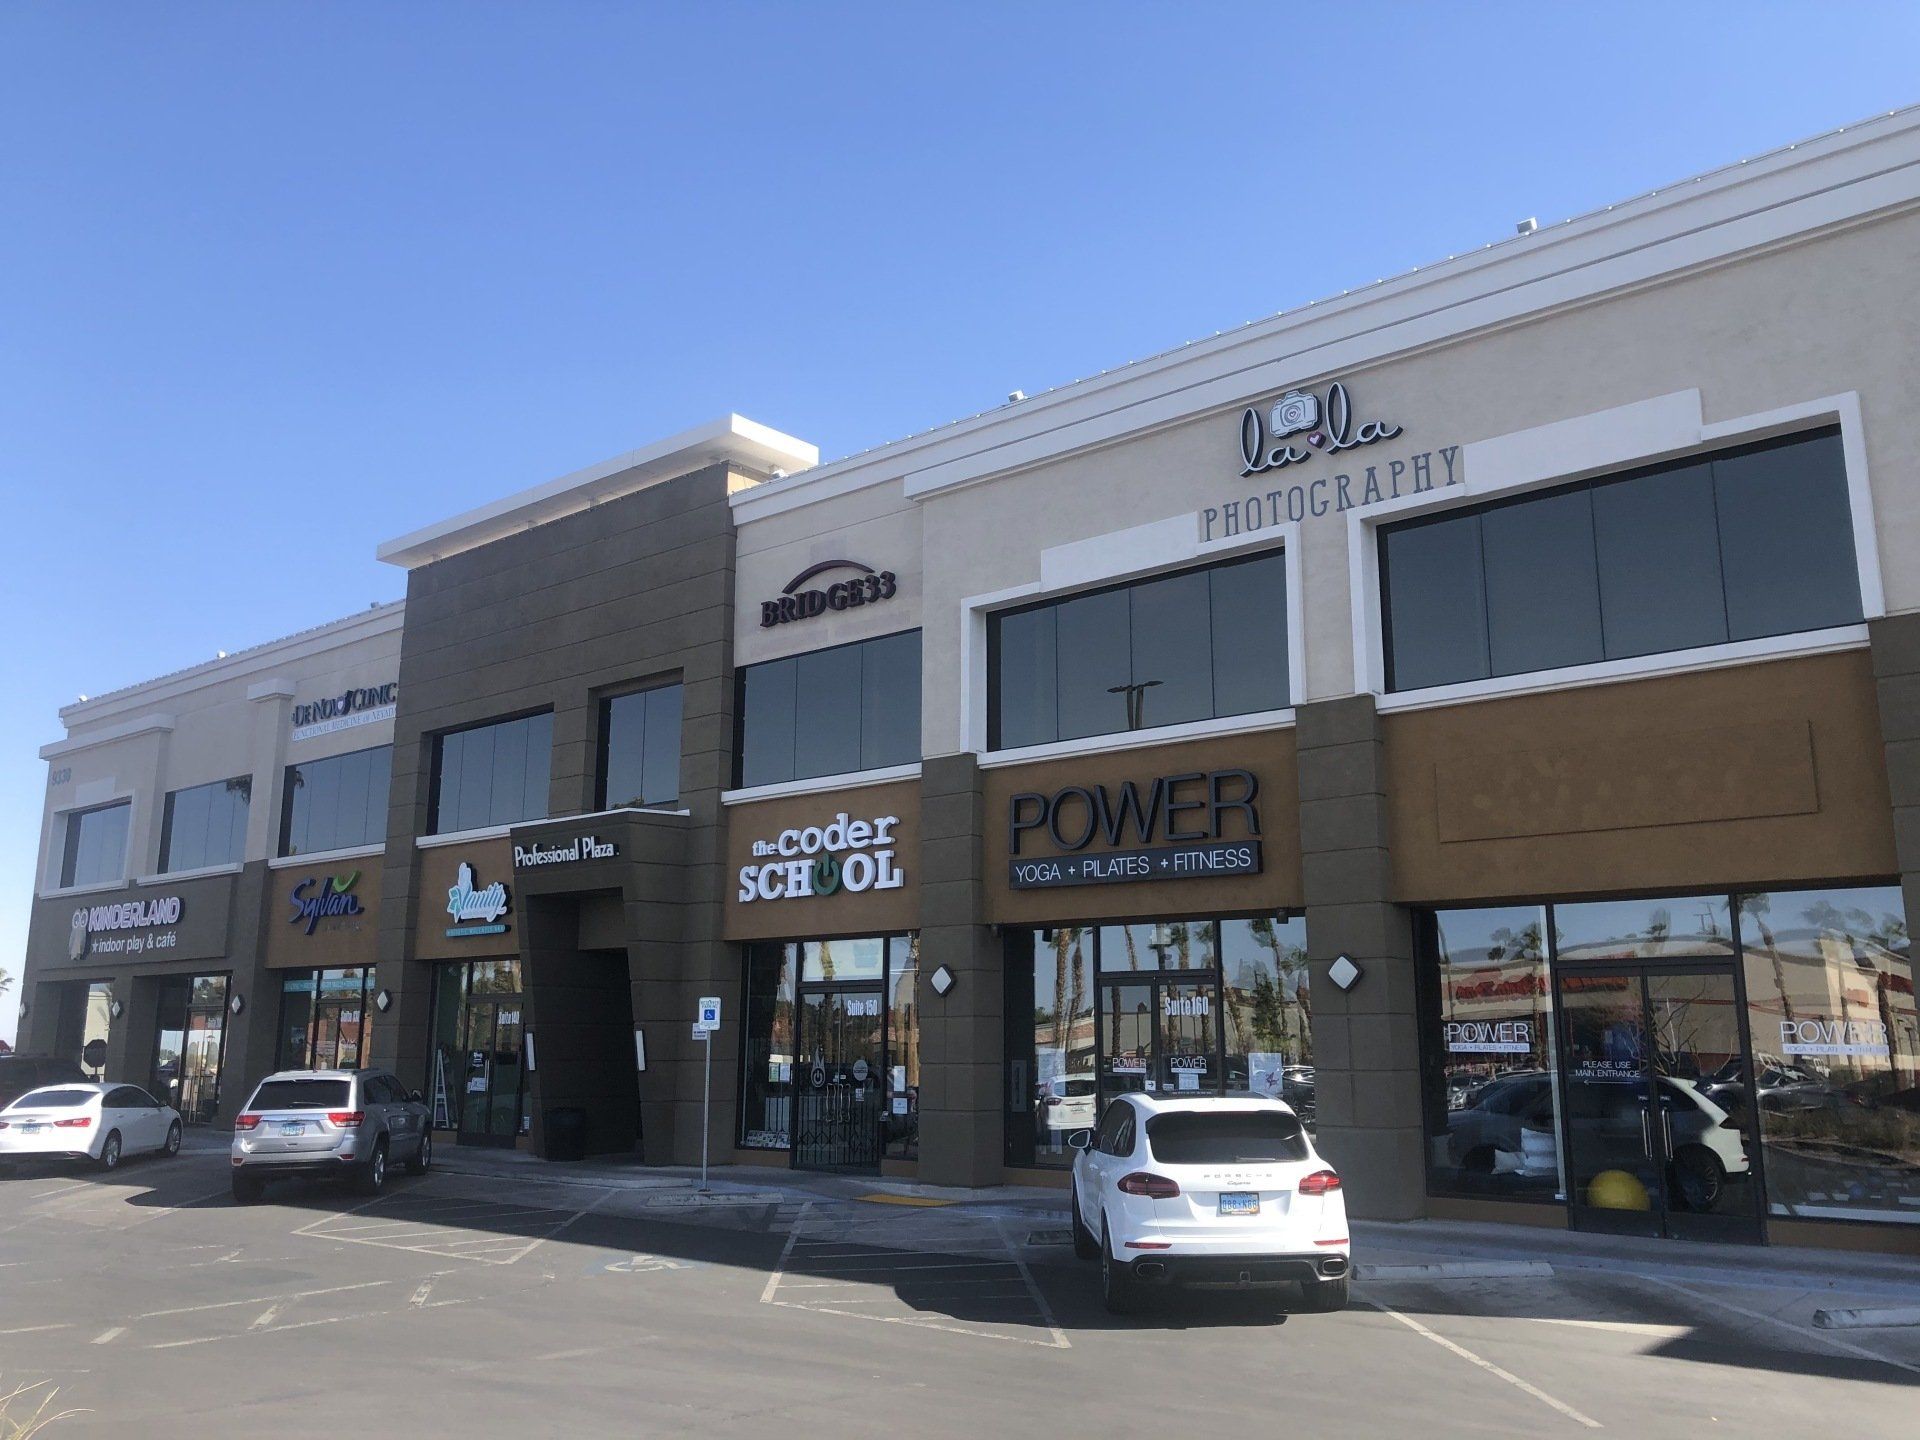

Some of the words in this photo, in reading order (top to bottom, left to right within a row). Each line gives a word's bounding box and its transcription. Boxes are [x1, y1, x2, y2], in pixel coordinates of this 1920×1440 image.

[1239, 407, 1312, 477] la
[1326, 382, 1404, 456] la
[1203, 445, 1460, 542] PHOTOGRAPHY
[760, 570, 897, 628] BRIDGE33
[372, 706, 395, 721] NEVAD
[1008, 769, 1261, 855] POWER
[752, 840, 779, 857] the
[778, 812, 900, 857] coder
[514, 837, 580, 868] Professional
[582, 836, 615, 859] Plaza
[1015, 863, 1062, 883] YOGA
[1083, 855, 1150, 878] PILATES
[1174, 848, 1252, 872] FITNESS
[88, 897, 181, 932] KINDERLAND
[288, 876, 362, 935] Sylvan
[98, 937, 125, 953] indoor
[126, 934, 145, 954] play
[147, 933, 153, 949] &
[156, 930, 176, 948] café
[848, 999, 864, 1016] Suite
[866, 999, 878, 1016] 150
[1447, 1022, 1529, 1043] POWER
[1112, 1057, 1147, 1069] POWER
[1171, 1057, 1207, 1069] POWER
[1575, 1069, 1595, 1077] MAIN
[1597, 1069, 1640, 1078] ENTRANCE
[1582, 1060, 1612, 1069] PLEASE
[1615, 1060, 1632, 1069] USE
